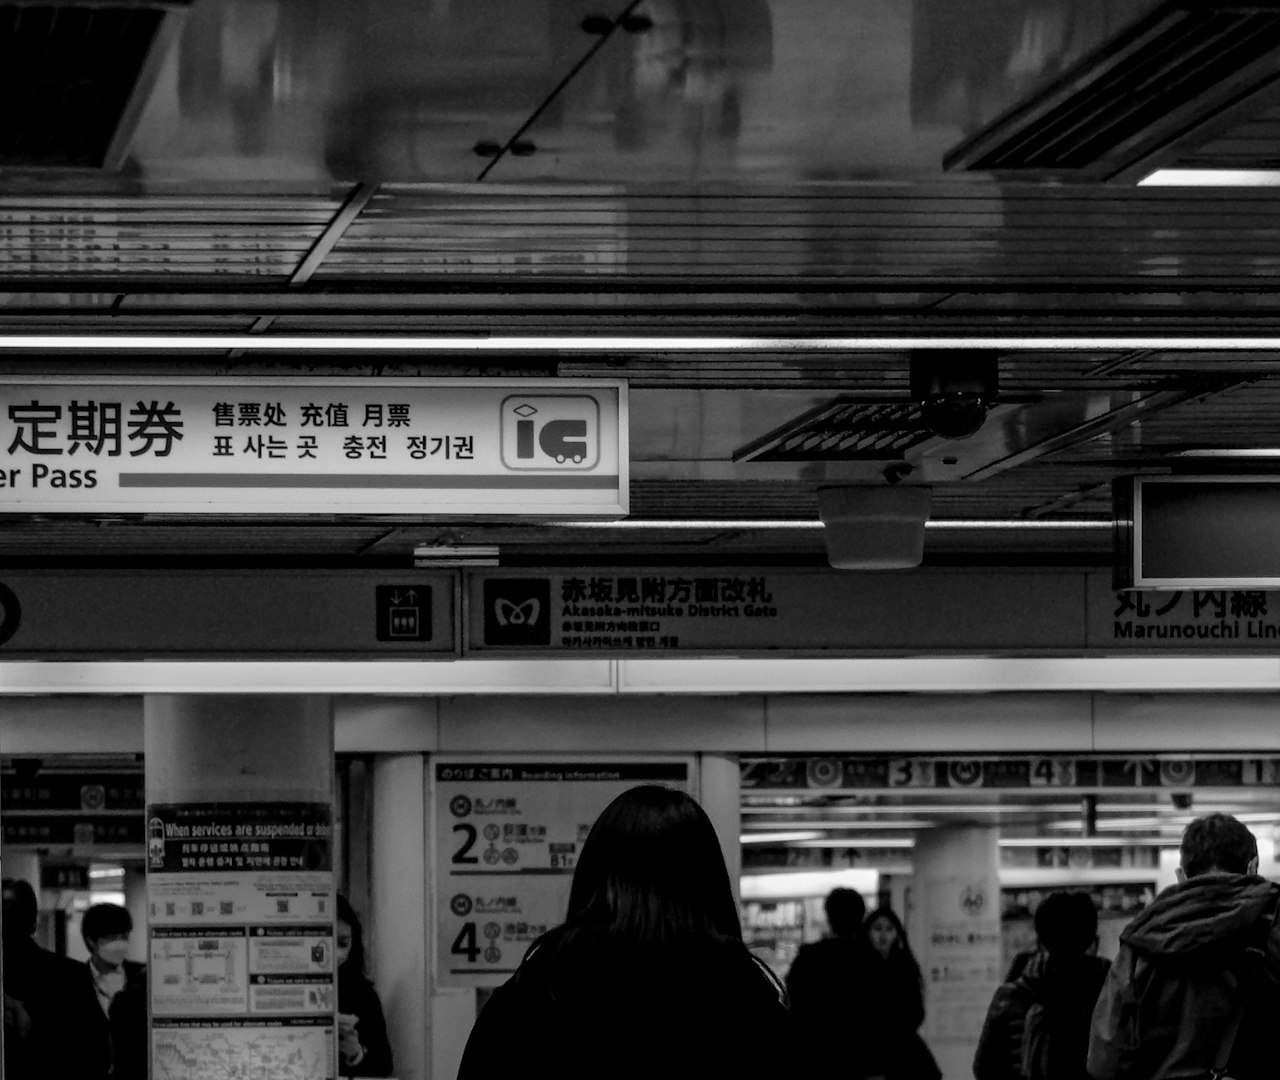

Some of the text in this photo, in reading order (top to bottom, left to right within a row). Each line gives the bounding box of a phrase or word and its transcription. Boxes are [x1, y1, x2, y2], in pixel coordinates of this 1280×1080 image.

[212, 402, 411, 427] 售票处 充值 月票
[212, 435, 475, 460] 표 사는 곳 충전 정기권
[32, 463, 98, 488] Pass
[561, 577, 773, 603] 赤坂見附方面改札
[561, 604, 778, 617] Akasaka-mitsuke District Gate
[1113, 621, 1240, 638] Marunouchi
[452, 823, 478, 863] 2
[451, 922, 481, 962] 4
